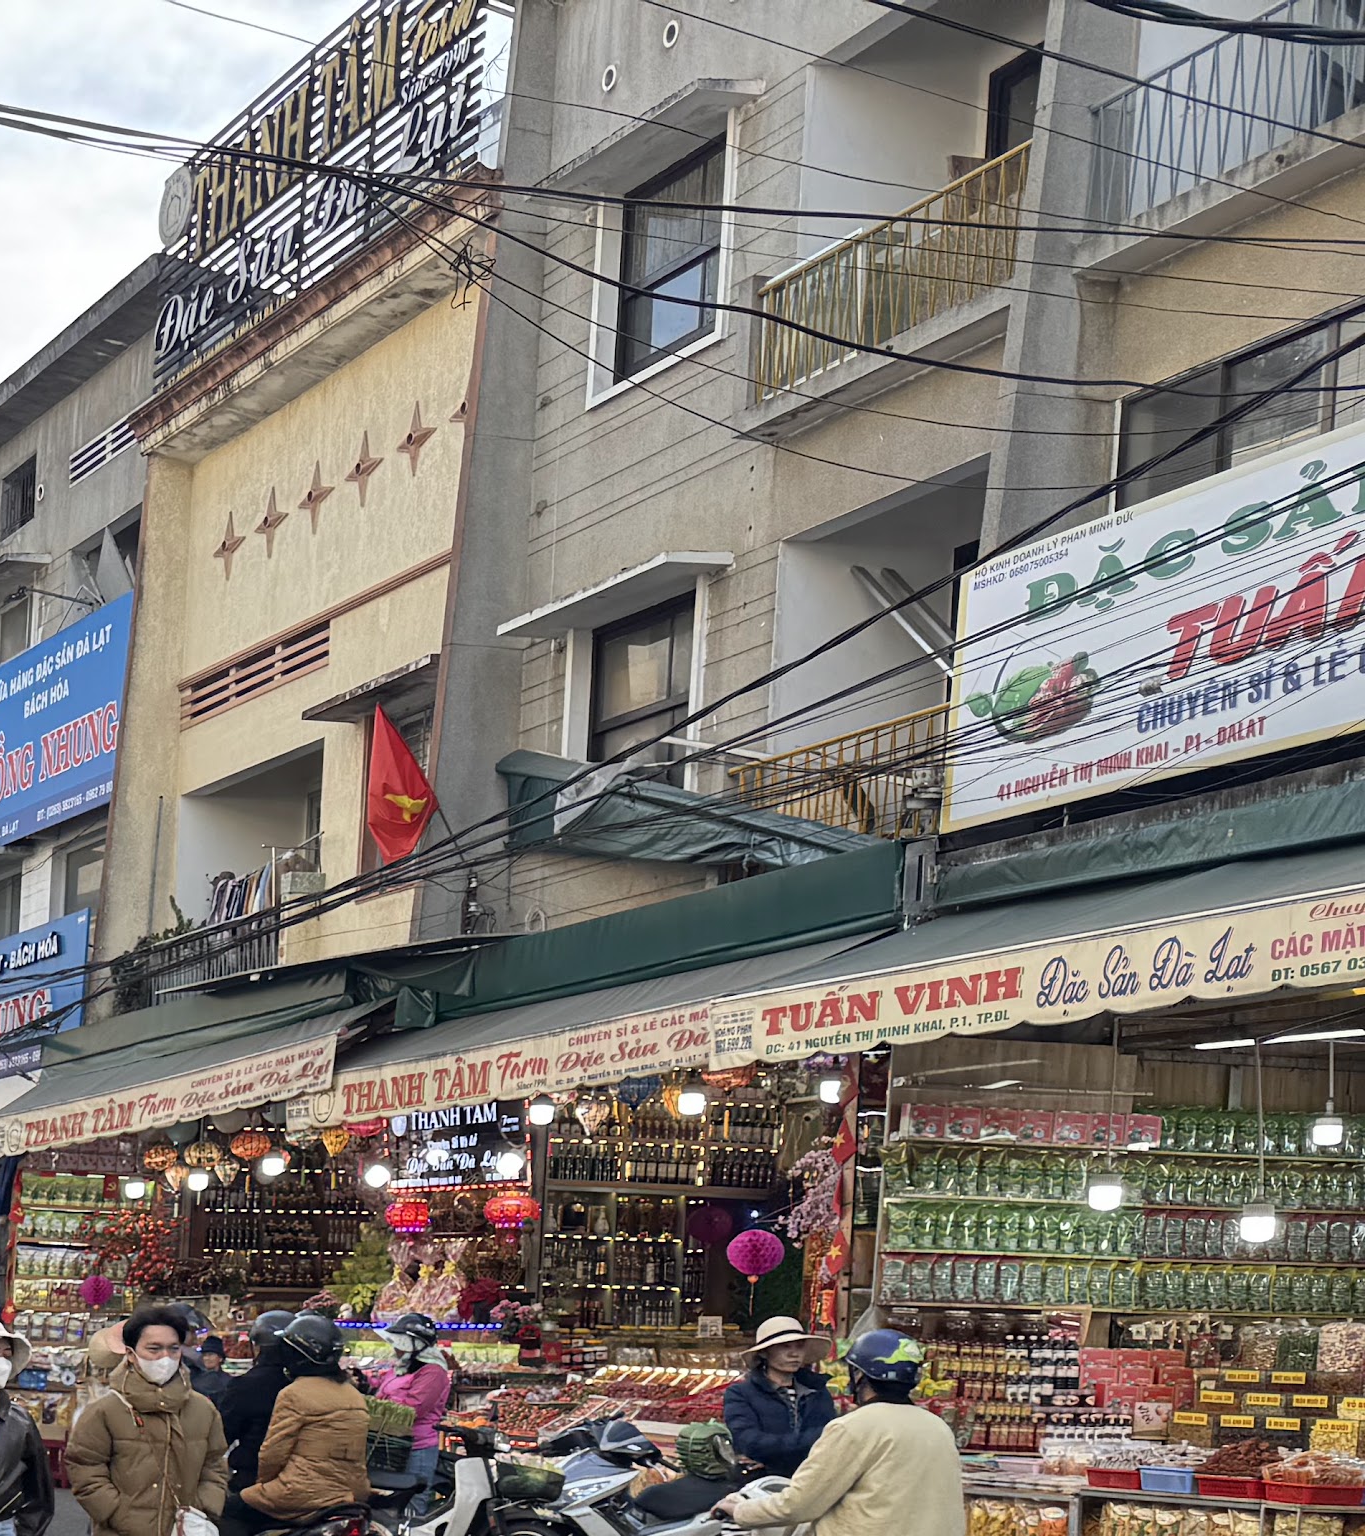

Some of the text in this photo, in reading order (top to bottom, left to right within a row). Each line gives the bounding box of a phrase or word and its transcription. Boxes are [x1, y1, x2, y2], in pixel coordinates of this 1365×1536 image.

[193, 79, 309, 262] THANH
[318, 5, 402, 160] TÂM
[989, 556, 1011, 574] KINH
[1013, 544, 1045, 566] DOANH
[1060, 528, 1087, 546] PHAN
[1088, 520, 1115, 537] MINH
[1025, 529, 1197, 626] ĐẶC
[10, 669, 33, 698] HÀNG
[36, 659, 54, 684] ĐẶC
[76, 637, 91, 660] ĐÀ
[92, 623, 113, 653] LẠT
[24, 688, 47, 719] BÁCH
[1137, 679, 1239, 734] CHUYÊN
[1282, 661, 1302, 694] &
[38, 700, 120, 784] NHUNG
[997, 784, 1012, 801] 41
[1014, 762, 1067, 798] NGUYỄN
[1073, 757, 1094, 786] THỊ
[1096, 750, 1132, 779] MINH
[1136, 741, 1169, 767] KHAI
[1184, 732, 1201, 754] P1
[9, 943, 36, 970] BÁCH
[1037, 926, 1258, 1017] Đặc Sản Đà Lạt
[1271, 931, 1314, 960] CÁC
[1271, 967, 1295, 982] ĐT:
[1300, 960, 1342, 978] 0567
[568, 1029, 612, 1047] CHUYÊN
[631, 1024, 640, 1035] &
[660, 1011, 685, 1028] CÁC
[762, 966, 1025, 1037] TUẤN VINH
[555, 1027, 711, 1074] Đặc Sản Đà
[765, 1043, 785, 1055] ĐC:
[788, 1040, 801, 1052] 41
[804, 1030, 853, 1049] NGUYỄN
[854, 1029, 873, 1044] THỊ
[876, 1024, 911, 1040] MINH
[976, 1008, 1010, 1025] TP.ĐL
[342, 1071, 428, 1117] THANH
[432, 1056, 492, 1104] TÂM
[496, 1050, 549, 1090] Farm
[24, 1110, 91, 1148] THANH
[92, 1098, 137, 1135] TÂM
[139, 1091, 177, 1119] Farm
[411, 1106, 461, 1131] THANH
